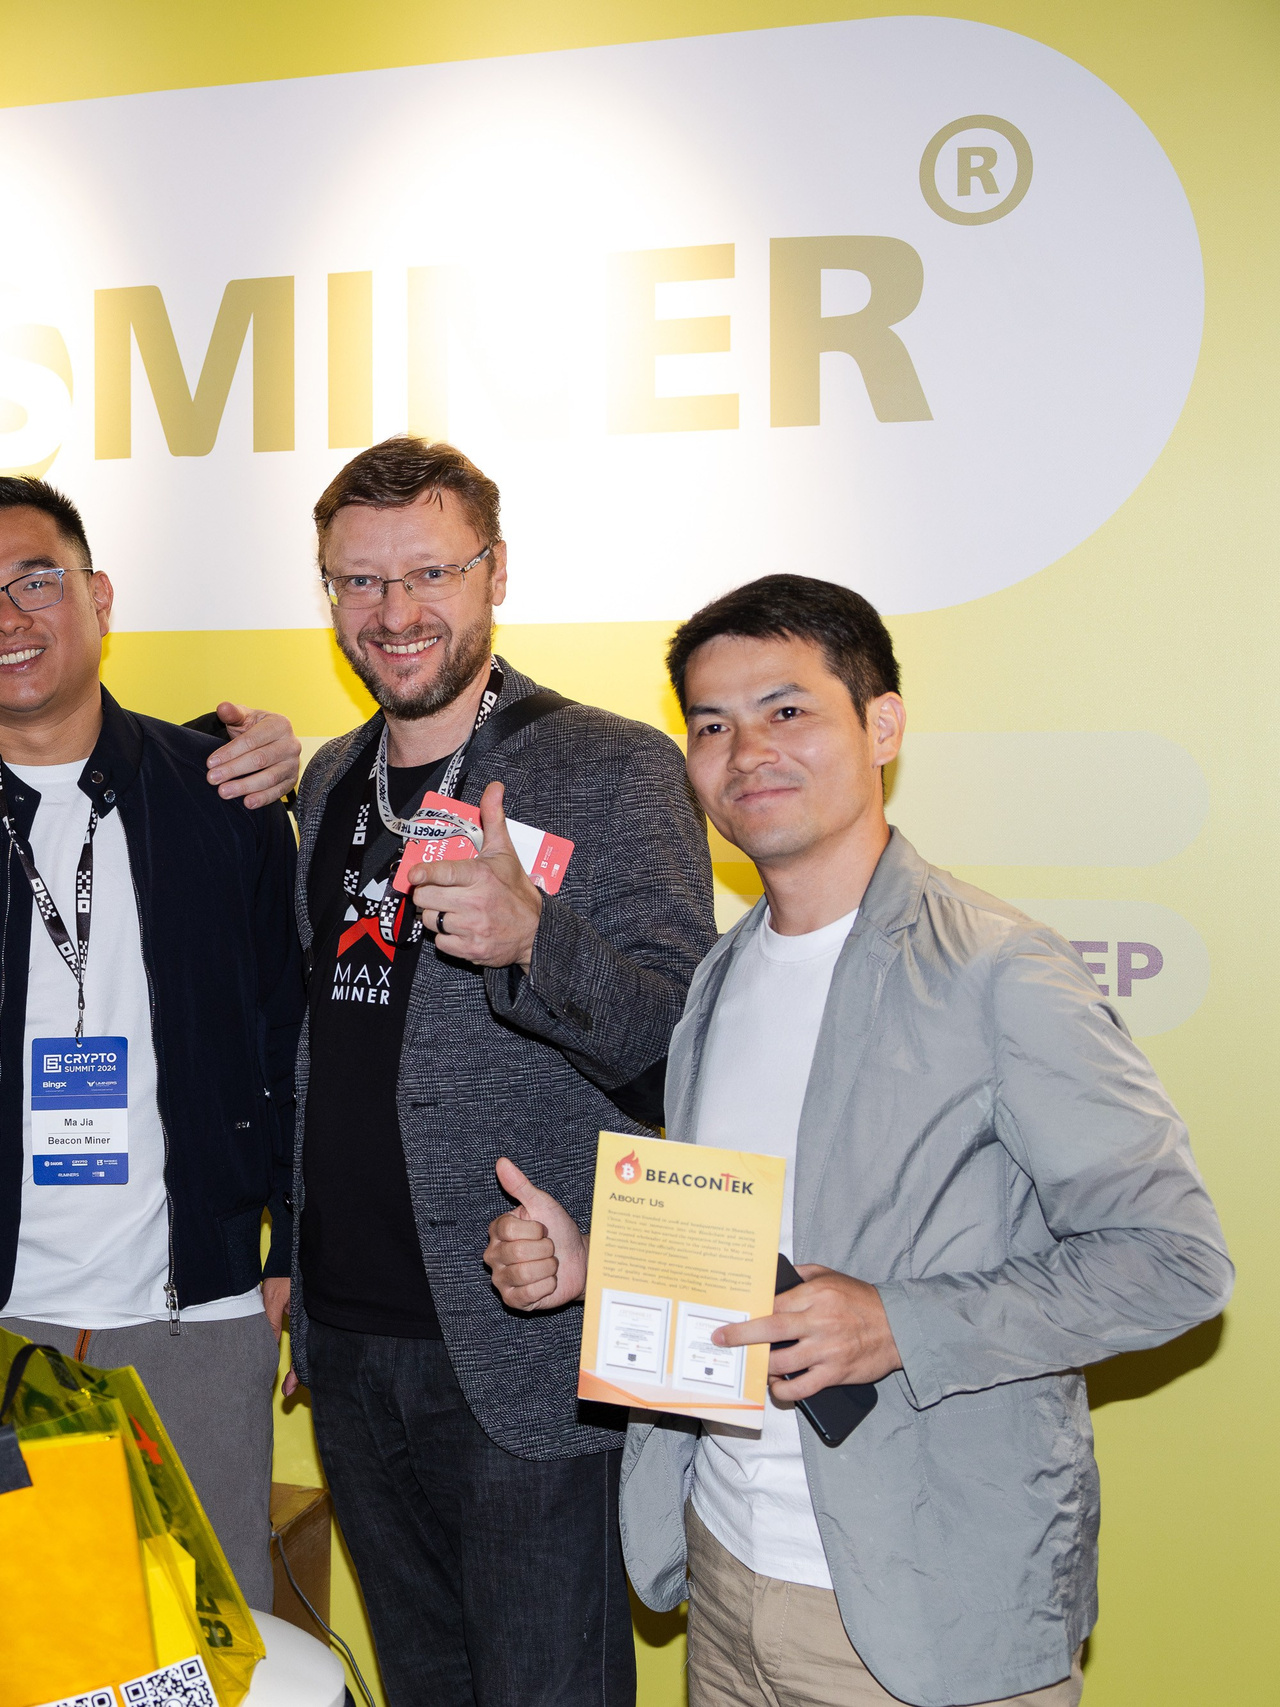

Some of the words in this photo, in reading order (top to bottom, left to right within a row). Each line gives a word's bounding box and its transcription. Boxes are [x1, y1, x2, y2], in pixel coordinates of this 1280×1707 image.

[333, 962, 392, 988] MAX
[331, 985, 390, 1005] MINER
[64, 1053, 117, 1064] CRYPTO
[64, 1065, 96, 1073] SUMMIT
[64, 1118, 78, 1127] Ma
[80, 1118, 94, 1126] Jia
[48, 1136, 82, 1145] Beacon
[84, 1136, 111, 1144] Miner
[645, 1169, 754, 1195] BEACONTEK
